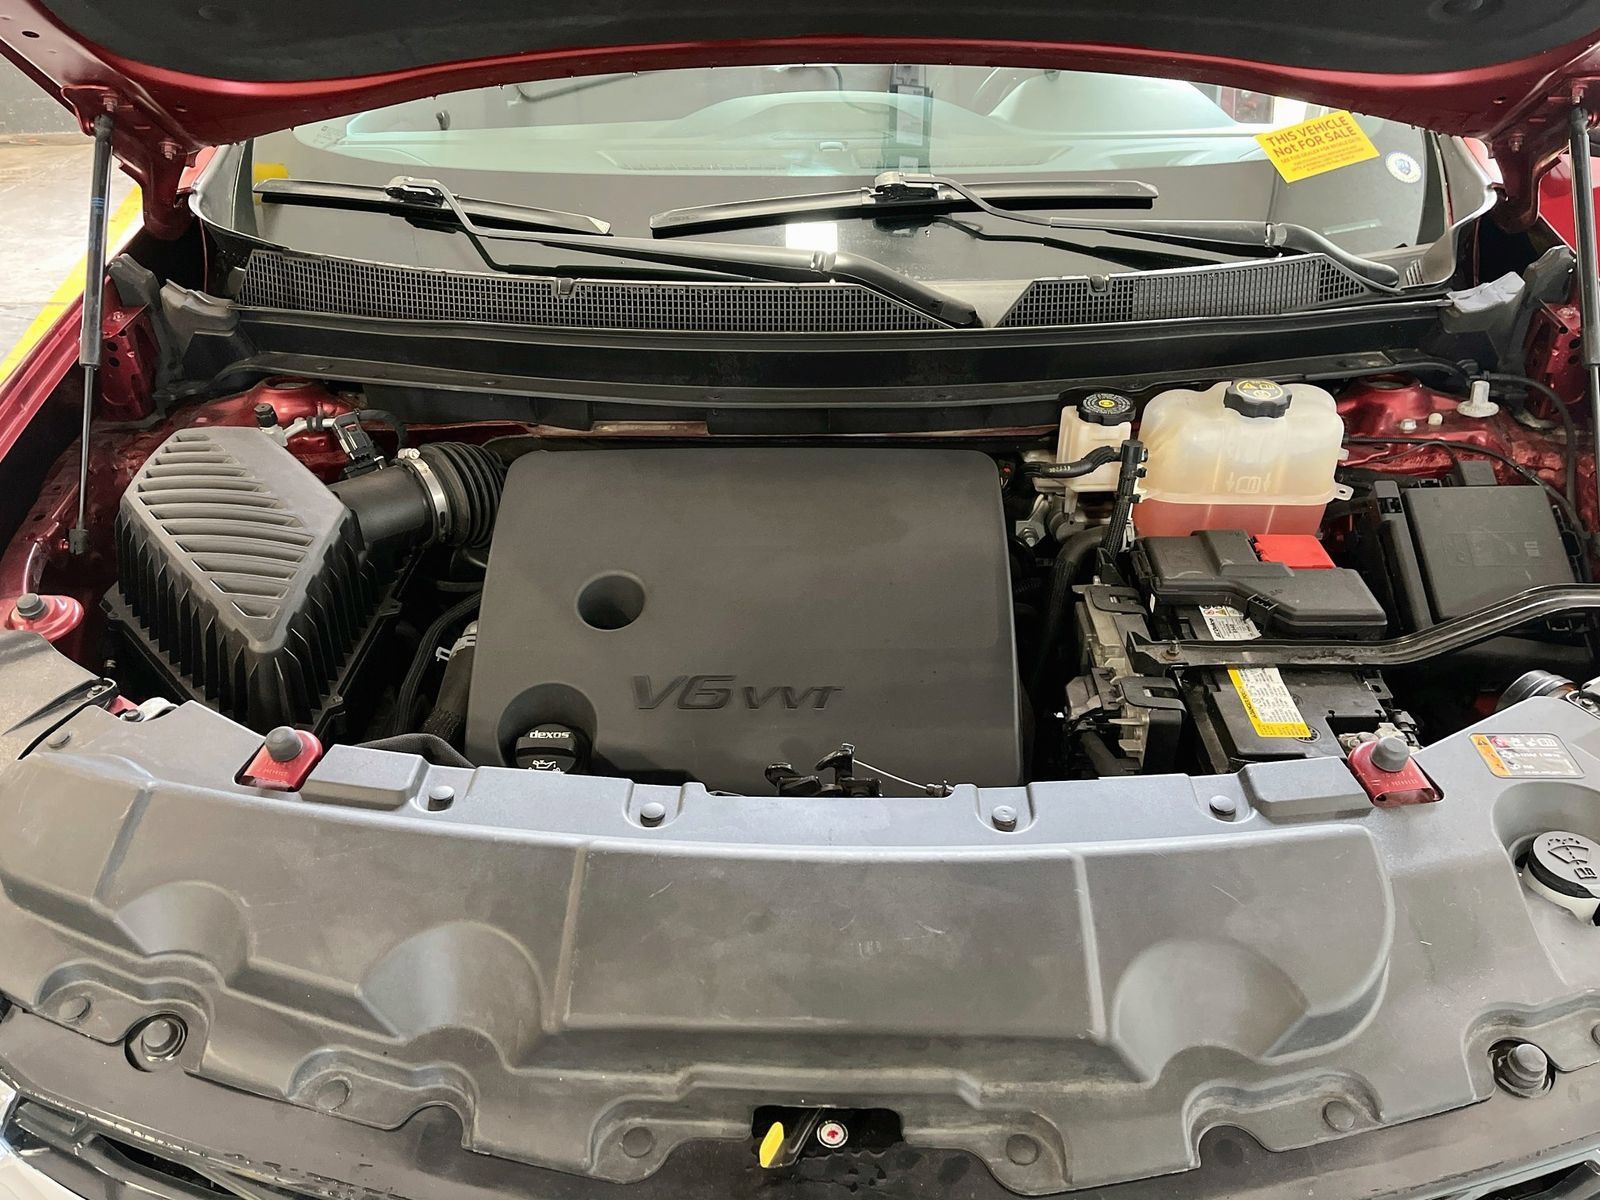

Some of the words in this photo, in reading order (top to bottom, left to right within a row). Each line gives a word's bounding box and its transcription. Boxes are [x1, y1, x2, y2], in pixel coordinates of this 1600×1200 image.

[1266, 131, 1298, 147] THIS
[1297, 116, 1349, 137] VEHICLE
[1273, 144, 1299, 157] Not
[1298, 136, 1325, 150] FOR
[1324, 126, 1357, 142] SALE
[631, 674, 737, 709] V6
[742, 686, 845, 710] VVT
[529, 729, 571, 738] dexos
